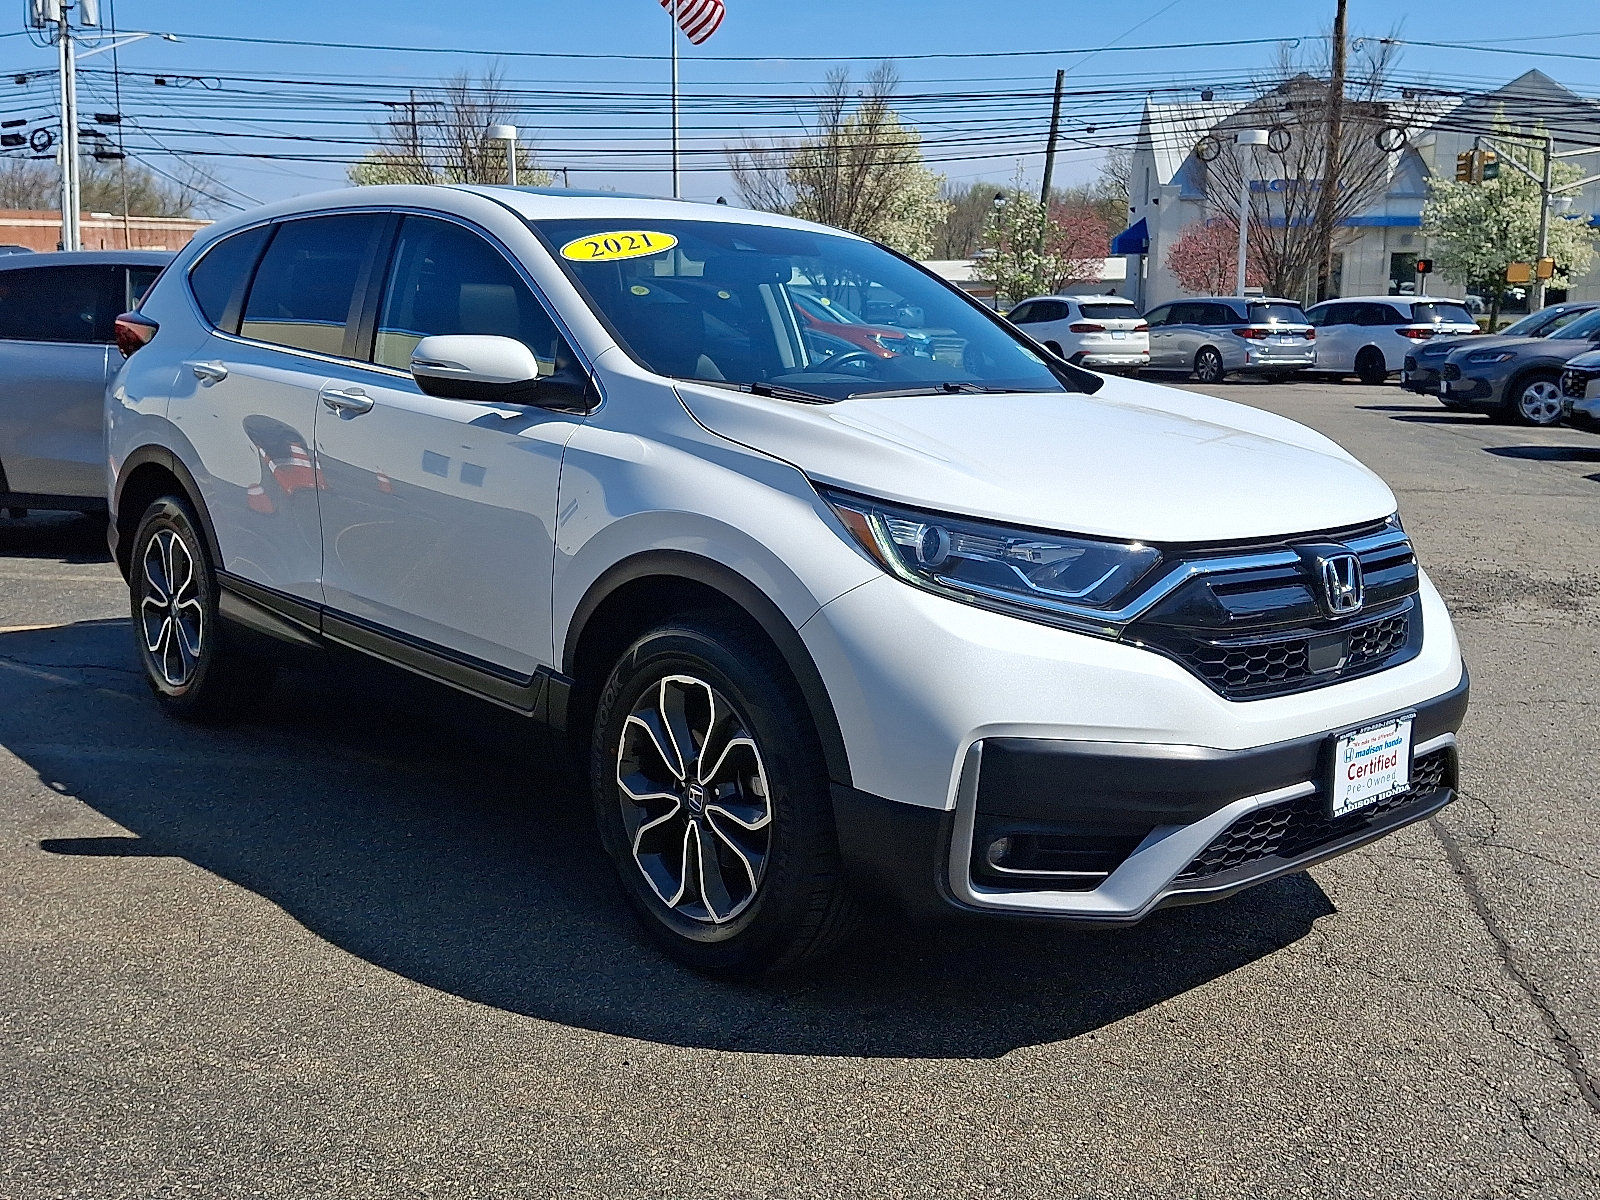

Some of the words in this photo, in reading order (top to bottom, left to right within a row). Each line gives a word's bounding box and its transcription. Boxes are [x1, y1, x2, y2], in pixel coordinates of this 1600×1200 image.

[585, 234, 653, 257] 2021
[1355, 744, 1383, 759] madison
[1384, 736, 1402, 749] honda
[1347, 749, 1397, 781] Certified
[1346, 769, 1396, 795] Pre-Owned
[1334, 795, 1377, 817] MADISON
[1378, 784, 1411, 801] HONDA
